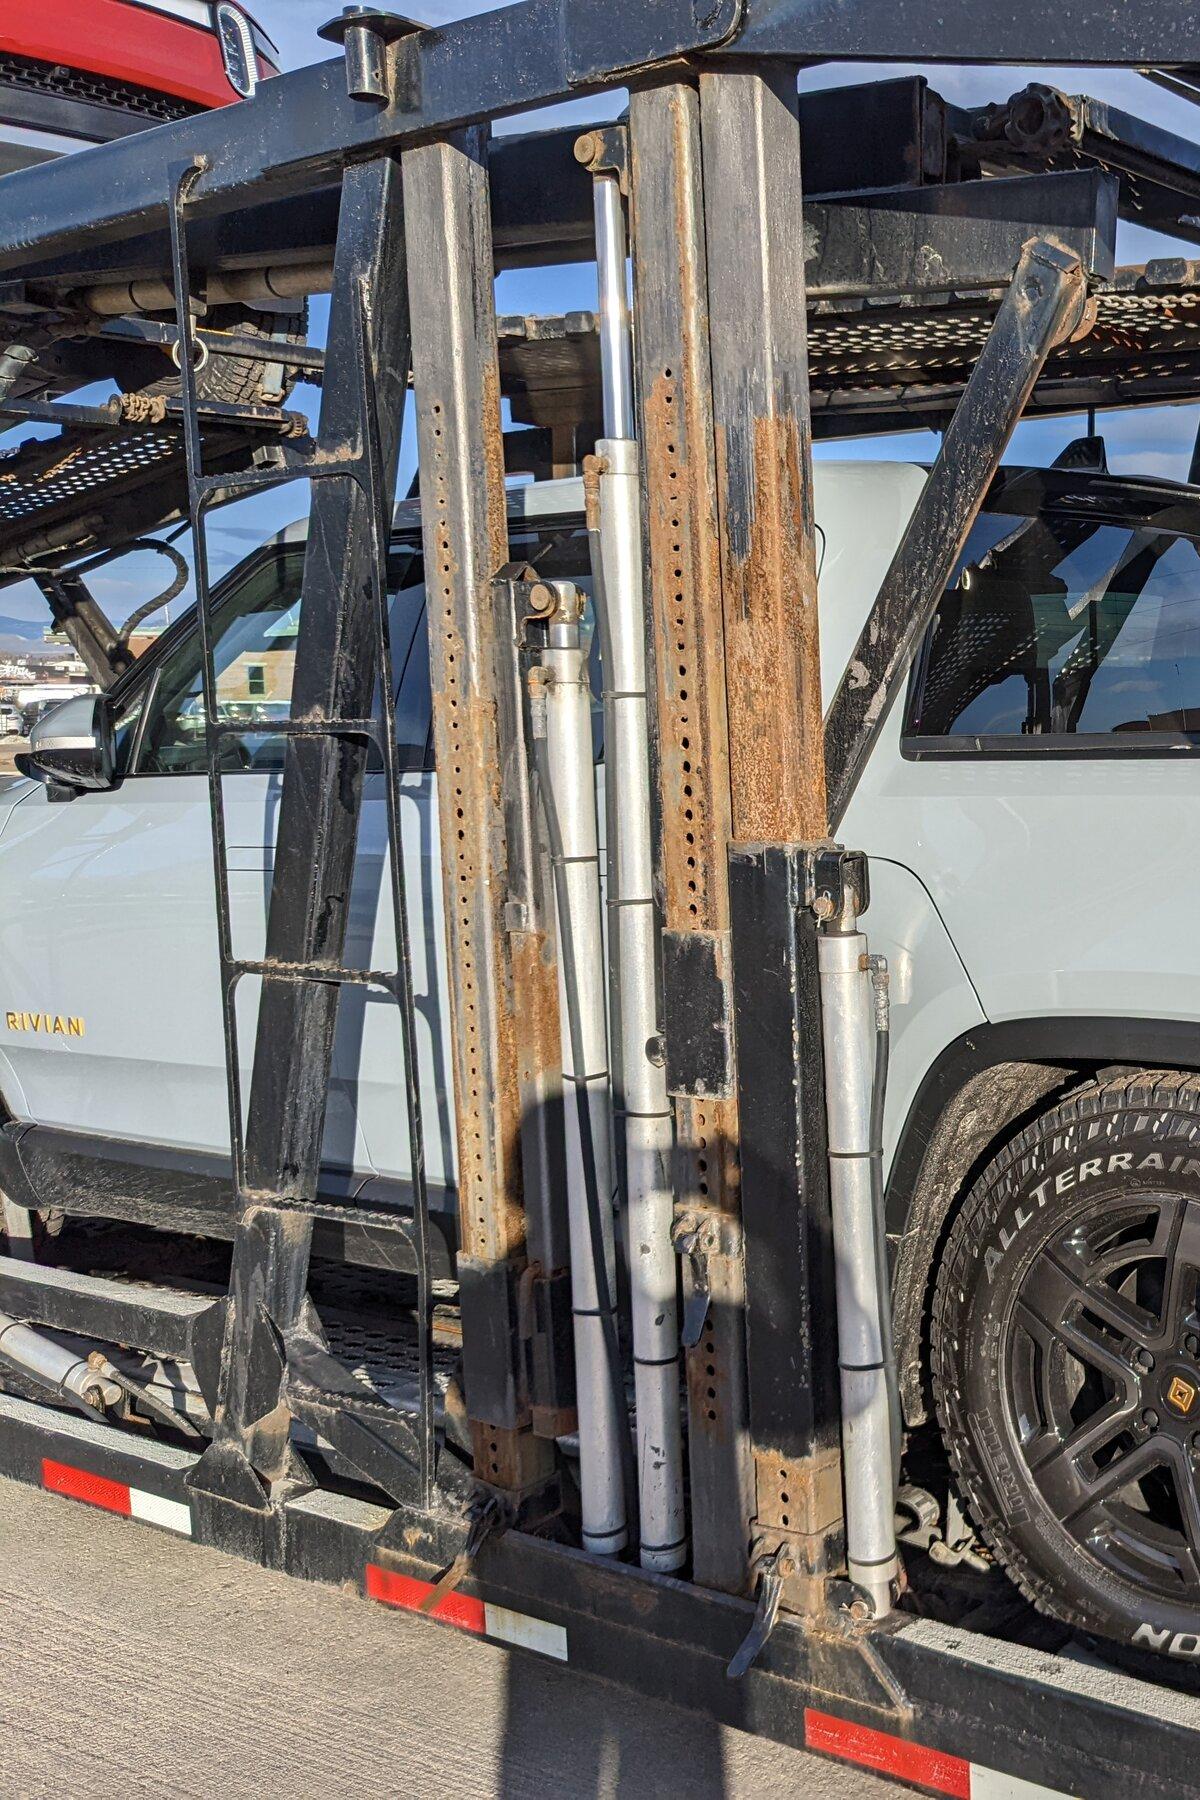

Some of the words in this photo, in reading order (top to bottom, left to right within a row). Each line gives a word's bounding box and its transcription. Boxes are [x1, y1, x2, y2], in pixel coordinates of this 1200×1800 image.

[6, 1012, 86, 1037] RIVIAN
[984, 1207, 1034, 1284] ALL
[967, 1407, 1031, 1529] PIRELLI
